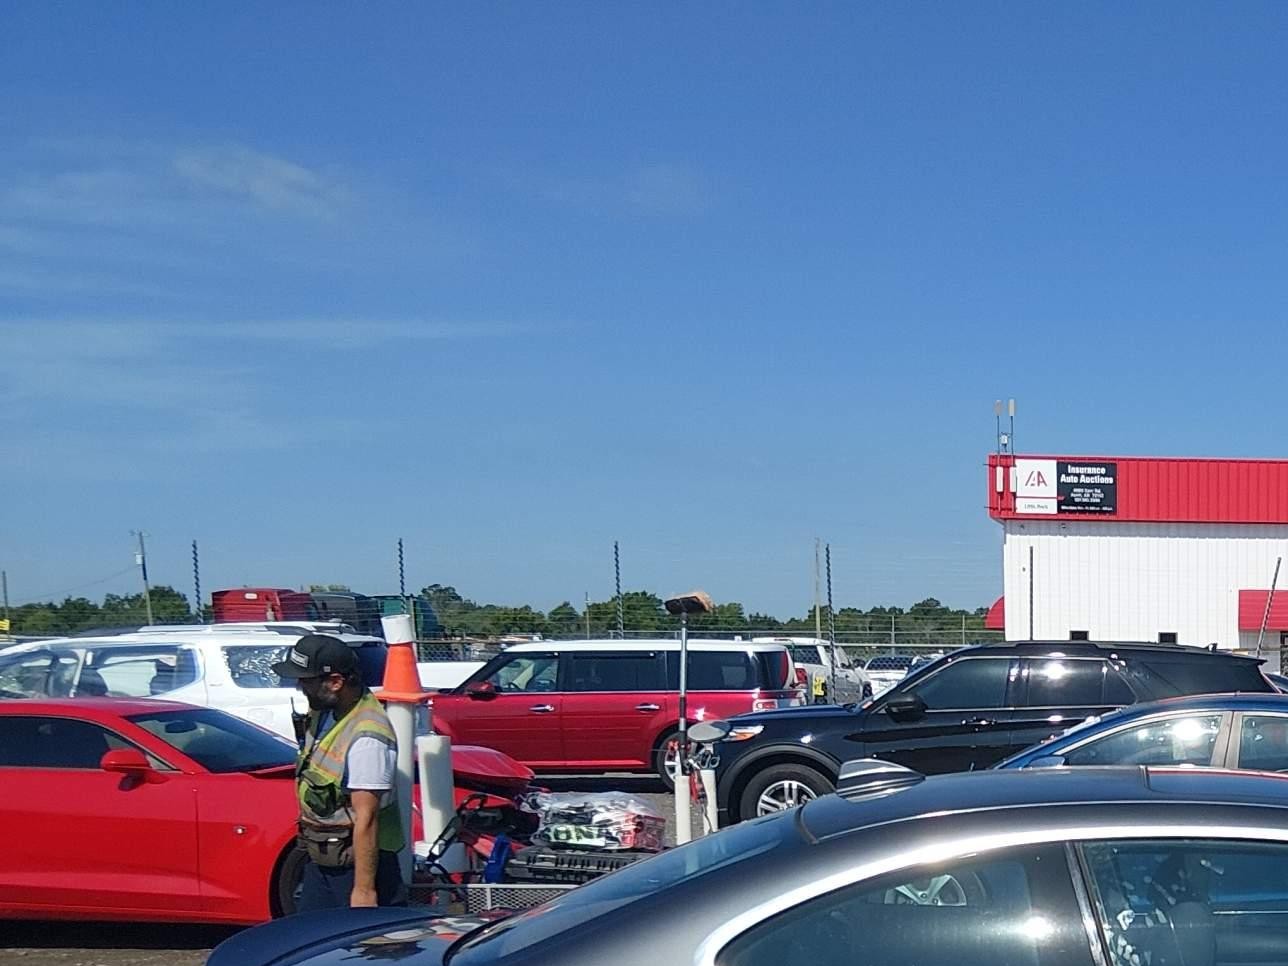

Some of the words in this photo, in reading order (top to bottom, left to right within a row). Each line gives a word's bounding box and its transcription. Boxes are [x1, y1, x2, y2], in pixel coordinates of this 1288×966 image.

[1067, 464, 1106, 475] Insurance
[1060, 474, 1079, 484] Auto
[1079, 474, 1114, 485] Auctions
